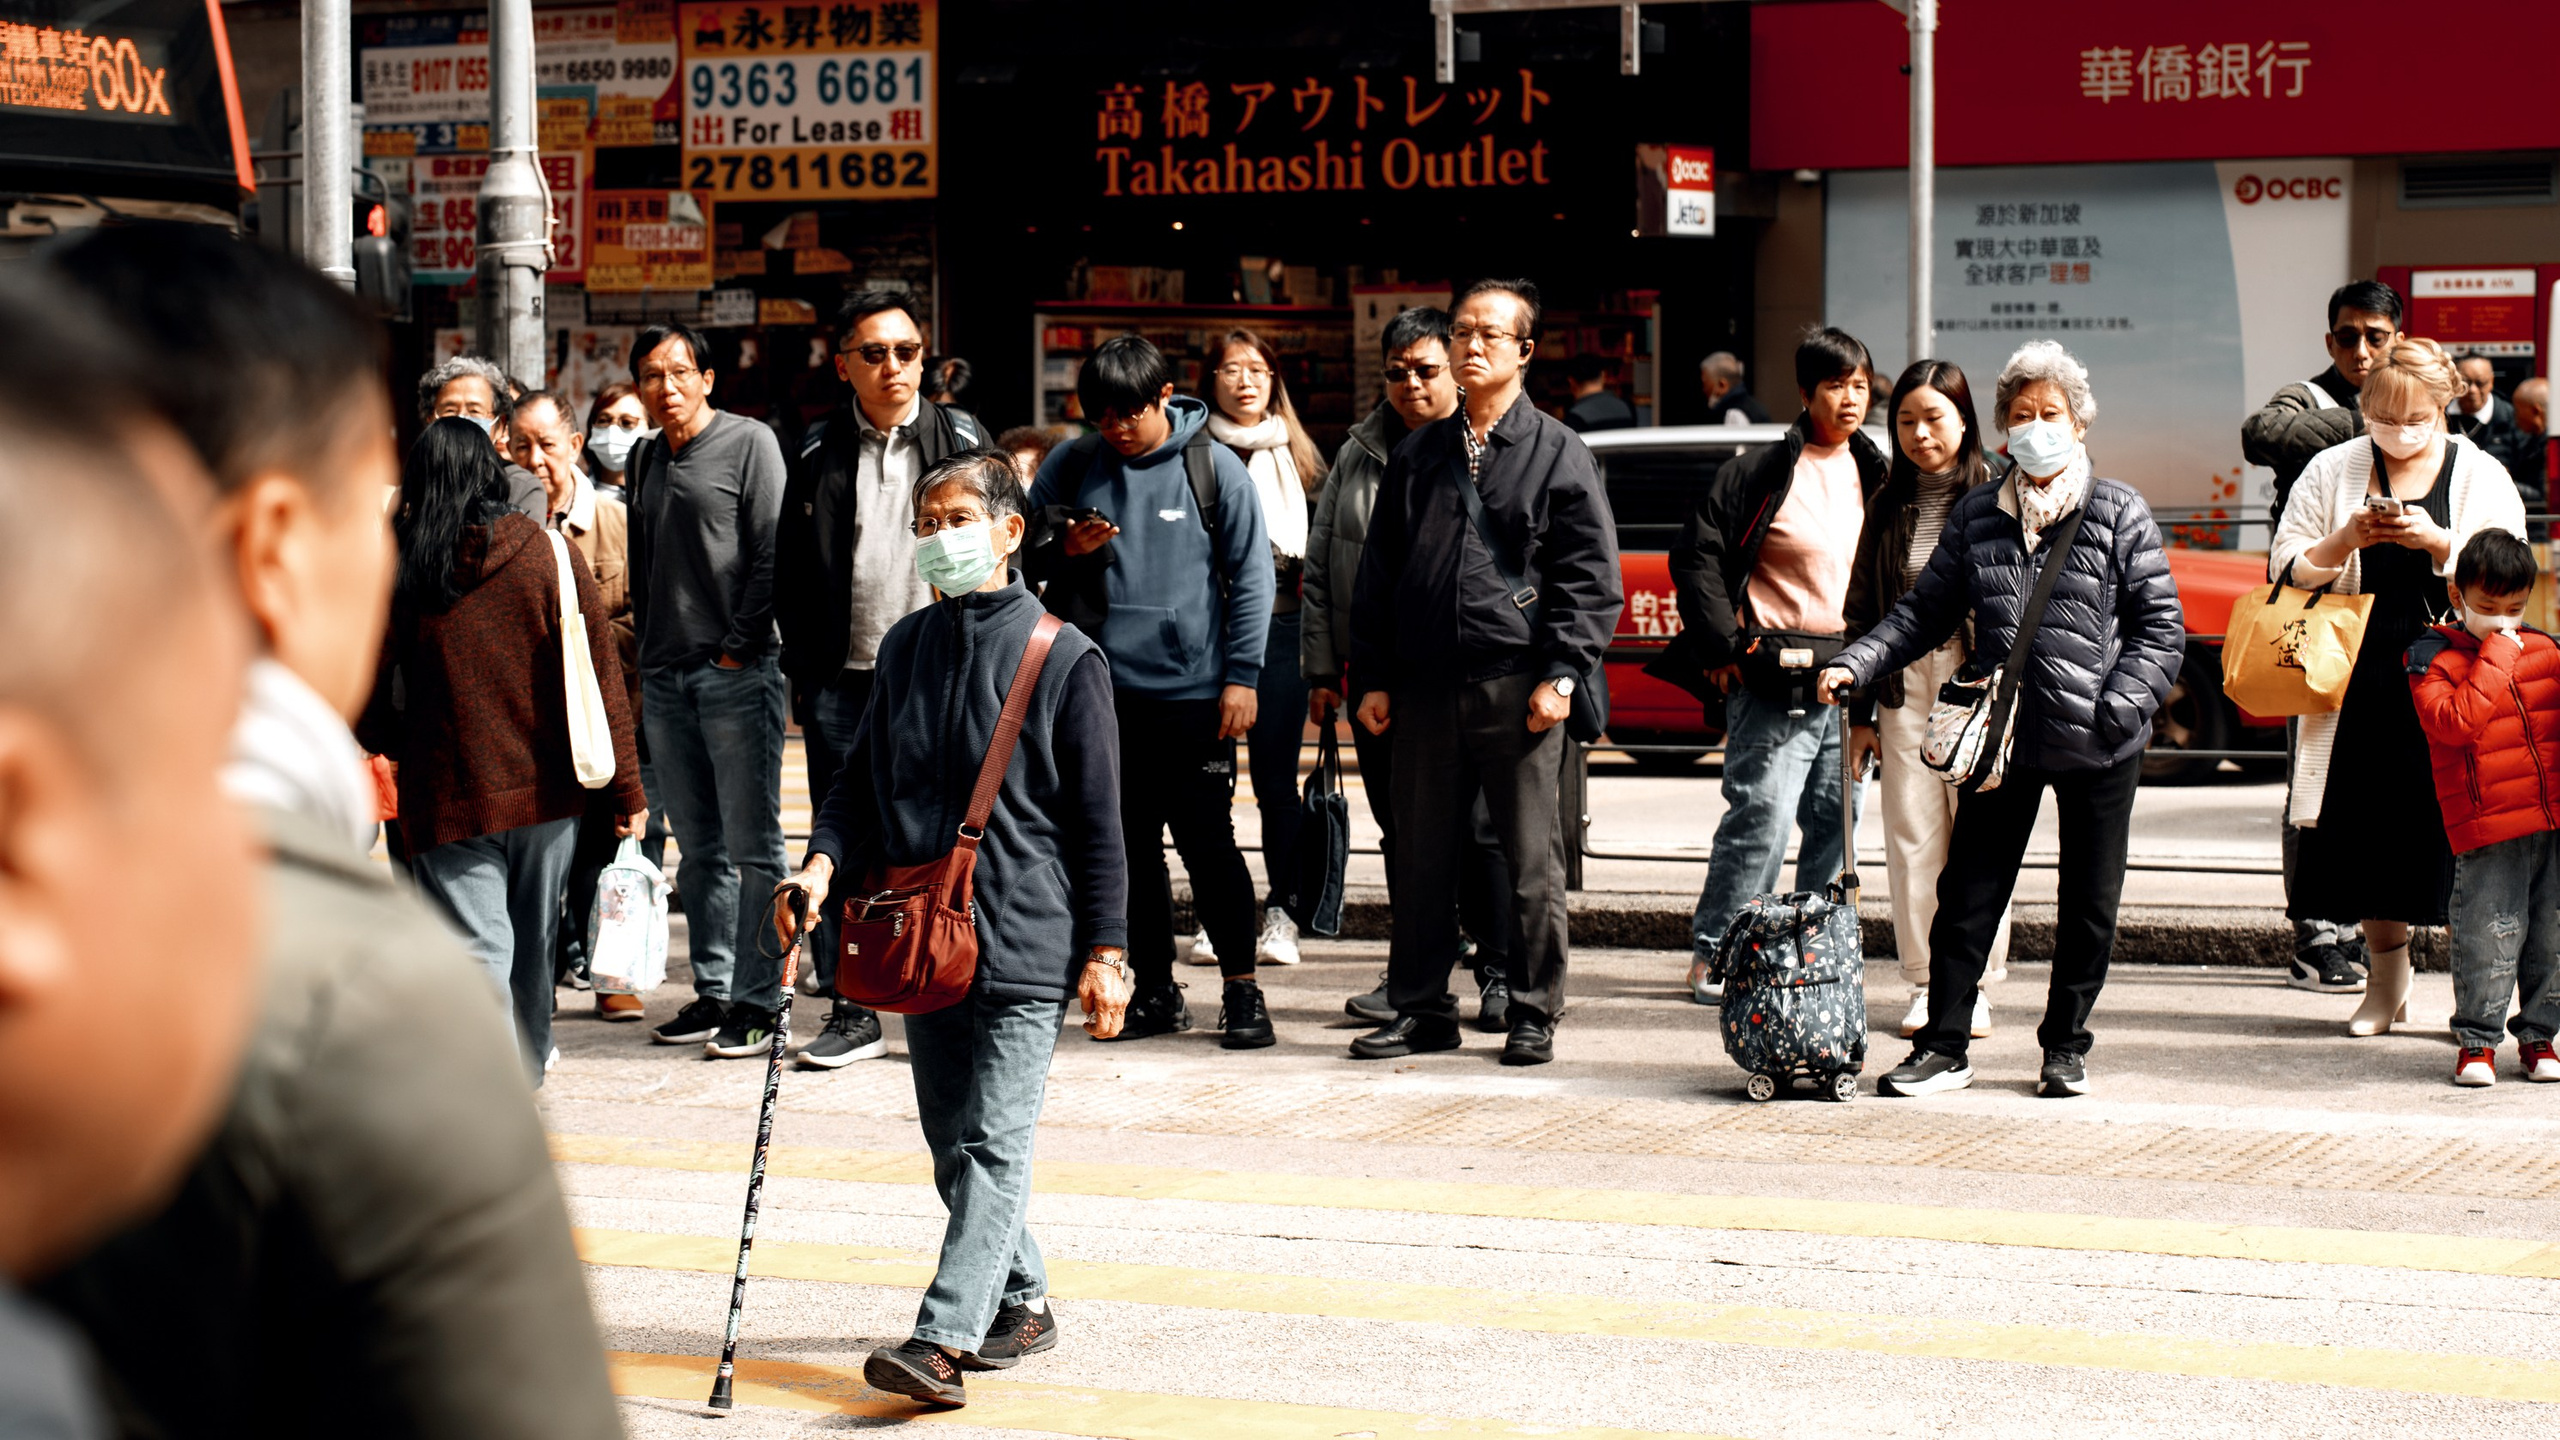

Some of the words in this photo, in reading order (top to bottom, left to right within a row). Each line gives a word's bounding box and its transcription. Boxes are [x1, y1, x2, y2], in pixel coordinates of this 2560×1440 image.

[732, 3, 921, 49] 永昇物業
[567, 59, 616, 82] 6650
[622, 57, 671, 80] 9980
[691, 62, 797, 109] 9363
[817, 57, 922, 104] 6681
[2080, 40, 2311, 104] 華僑銀行
[692, 114, 724, 146] 出
[733, 117, 781, 145] For
[792, 115, 882, 143] Lease
[889, 108, 922, 142] 租
[1097, 68, 1551, 140] 高橋アウトレット
[690, 151, 928, 191] 27811682
[1097, 142, 1365, 196] Takahashi
[1381, 134, 1550, 190] Outlet
[2267, 177, 2342, 200] OCBC
